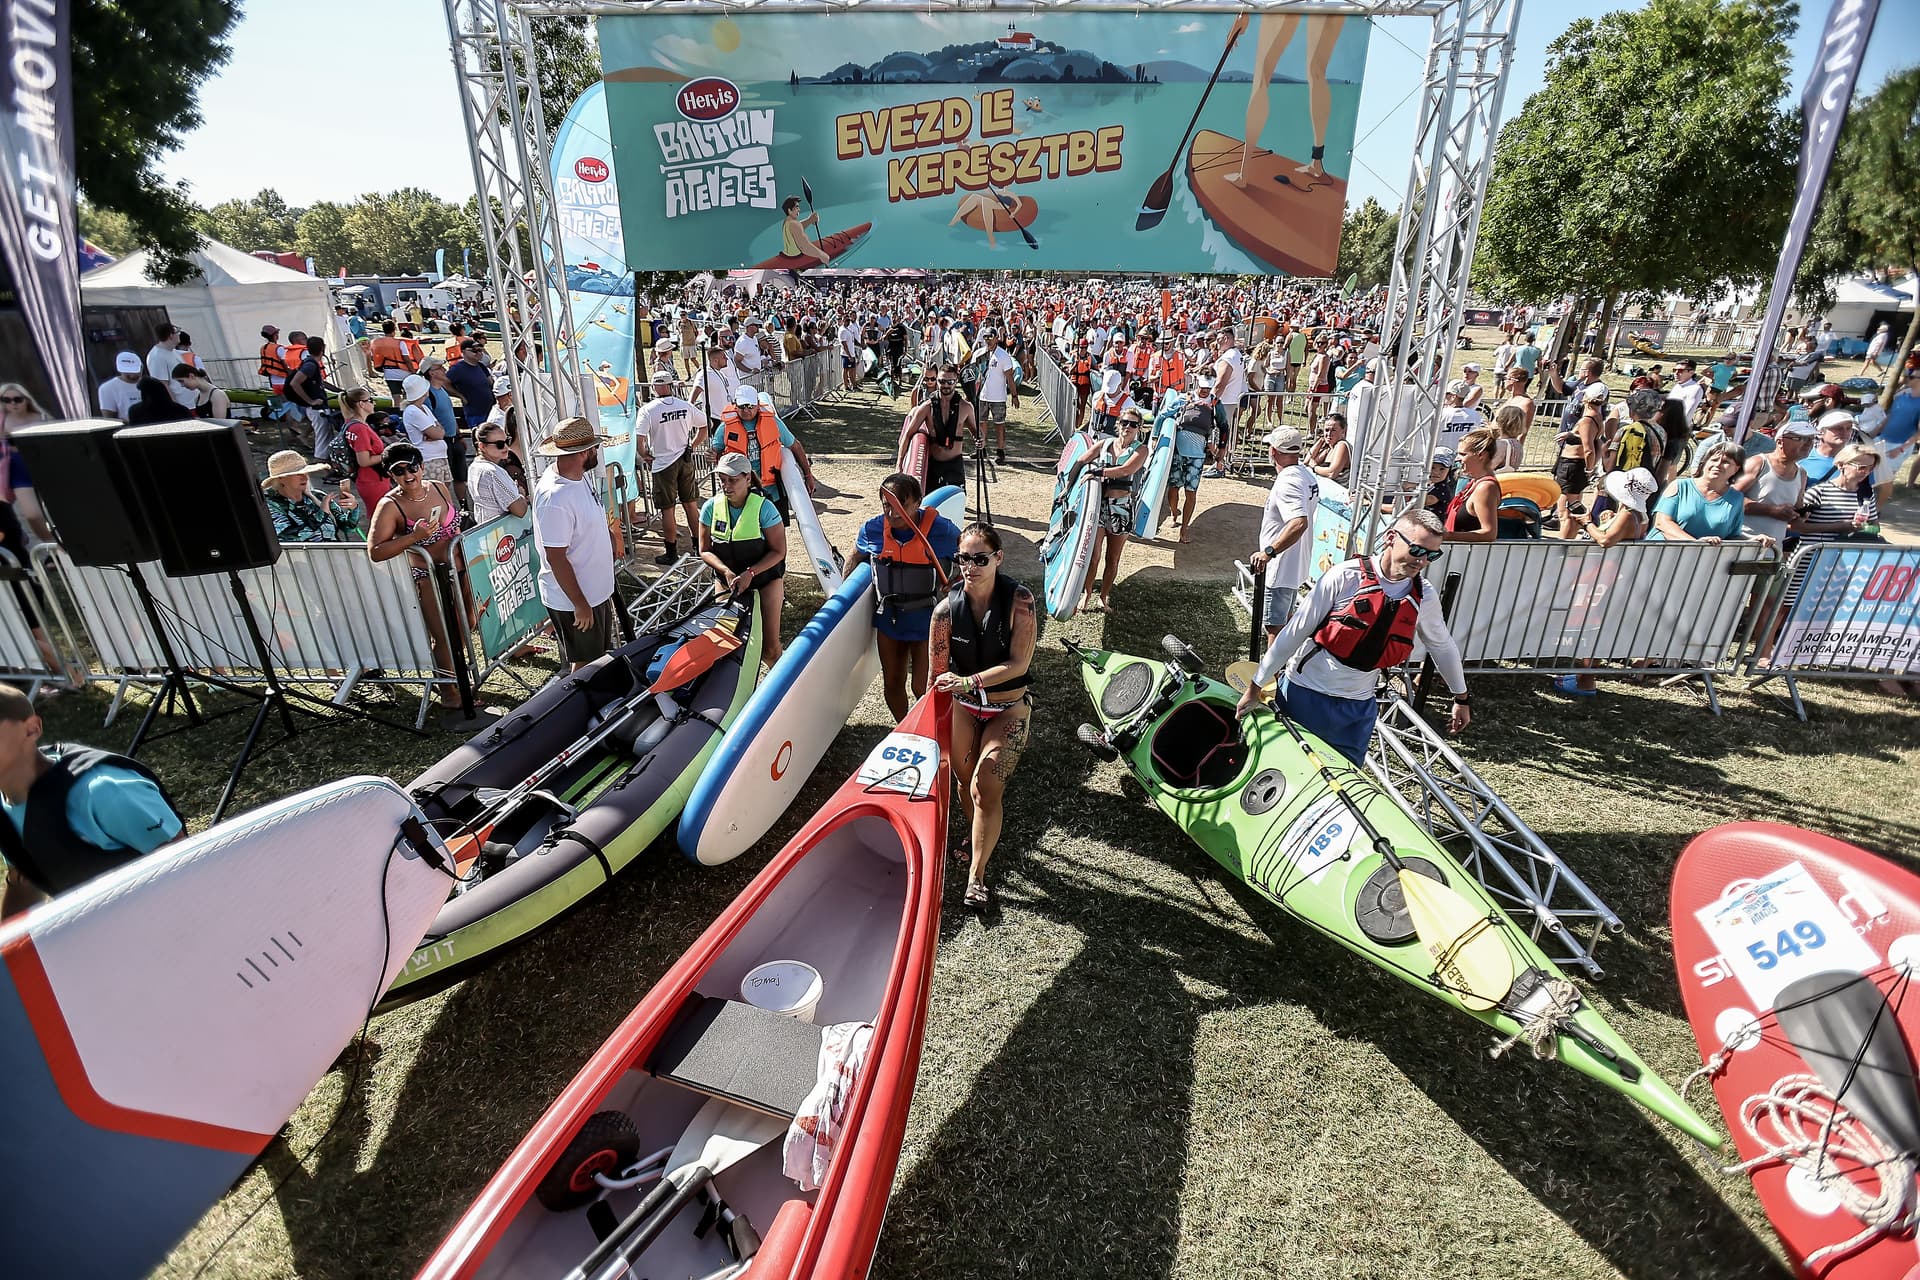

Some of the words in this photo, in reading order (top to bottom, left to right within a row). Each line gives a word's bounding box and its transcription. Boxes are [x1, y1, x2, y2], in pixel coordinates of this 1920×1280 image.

[682, 88, 734, 111] Hervis
[653, 109, 775, 163] BALATON
[836, 97, 972, 160] EVEZD
[980, 89, 1014, 138] LE
[578, 162, 607, 178] Hervis
[888, 125, 1124, 203] KERESZTBE
[558, 176, 619, 206] BALATO
[20, 152, 62, 262] GET
[659, 409, 688, 424] STAFF
[1442, 422, 1475, 433] STAFF
[495, 541, 515, 561] Heris
[882, 746, 927, 766] 439
[1308, 823, 1343, 857] 189
[1746, 920, 1826, 970] 549
